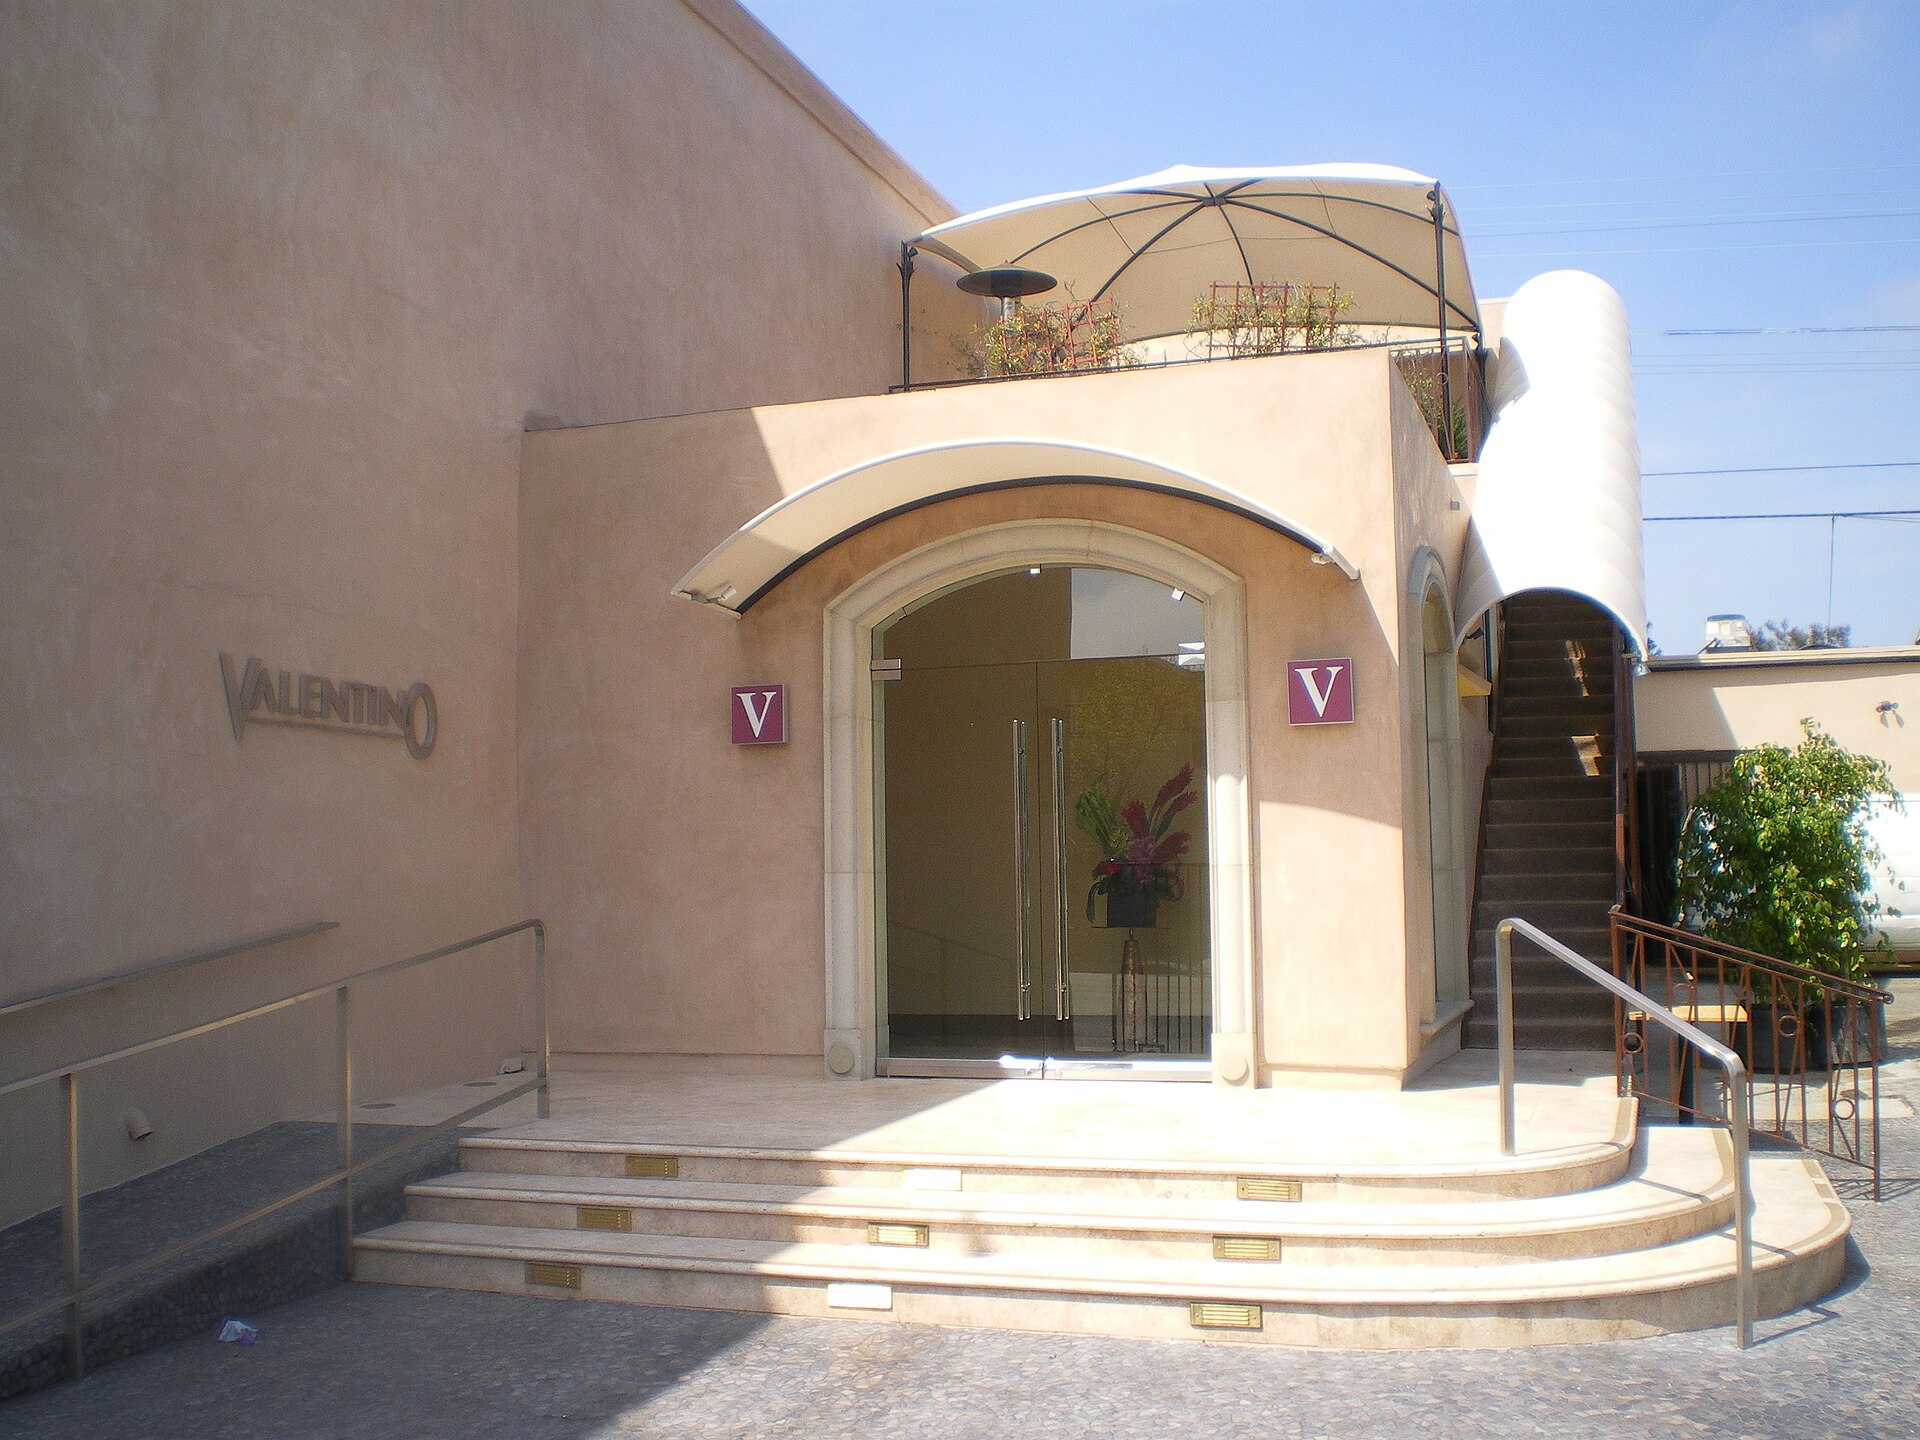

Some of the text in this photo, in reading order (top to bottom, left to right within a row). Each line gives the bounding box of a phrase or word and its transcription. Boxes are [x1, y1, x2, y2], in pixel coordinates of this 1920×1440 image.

[219, 652, 438, 760] VALENTINO
[736, 691, 777, 738] V
[1294, 666, 1344, 718] V
